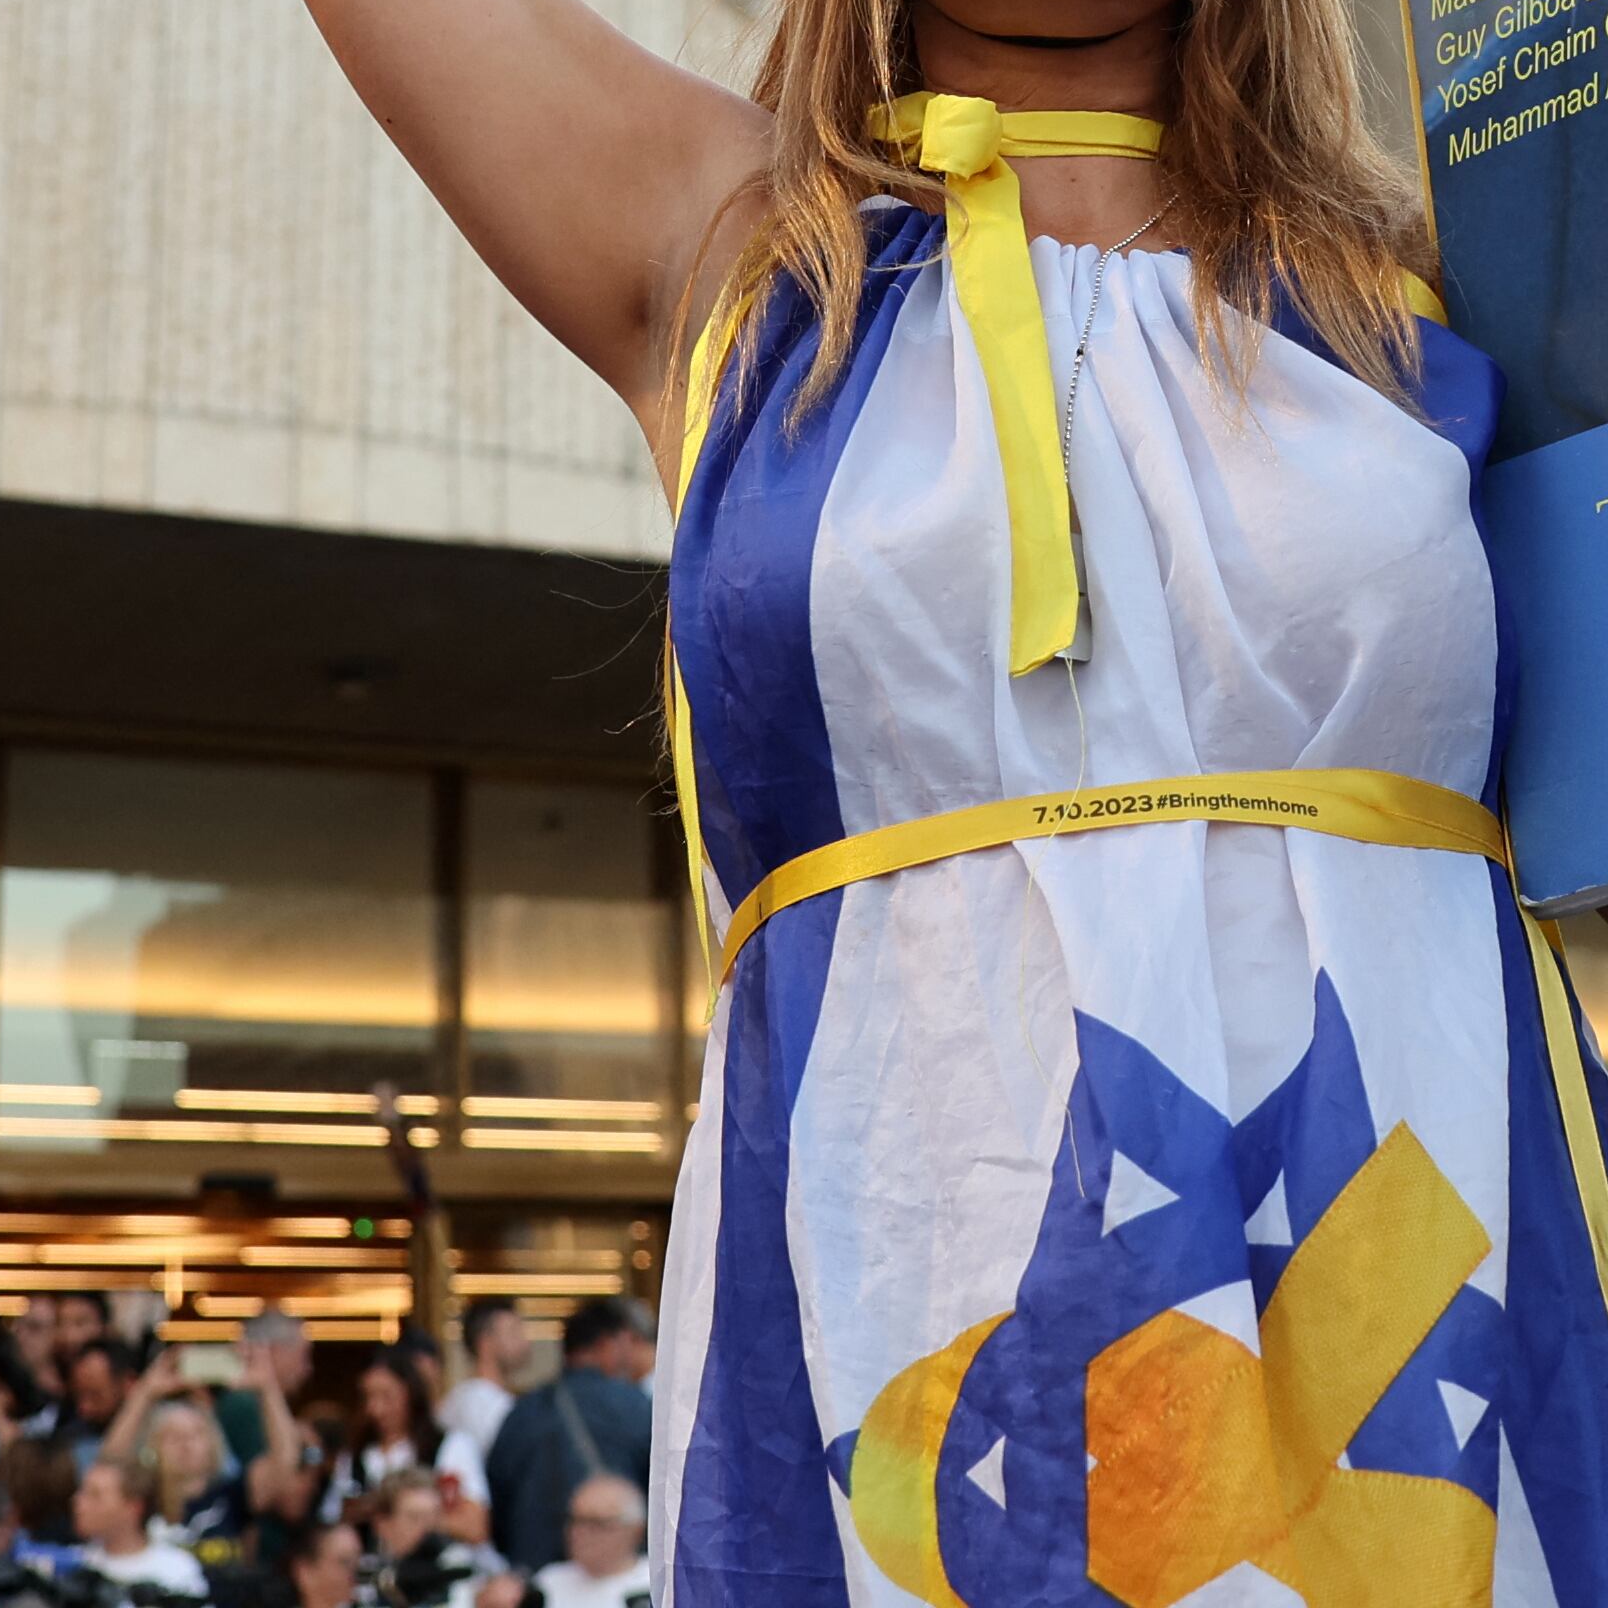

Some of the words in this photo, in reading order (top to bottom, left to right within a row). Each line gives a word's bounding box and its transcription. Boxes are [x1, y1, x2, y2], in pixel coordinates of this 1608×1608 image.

[1435, 24, 1488, 66] Guy
[1439, 57, 1507, 111] Yosef
[1512, 26, 1599, 83] Chaim
[1448, 72, 1600, 167] Muhammad
[1033, 794, 1155, 824] 7.10.2023
[1156, 792, 1319, 817] #Bringthemhome
